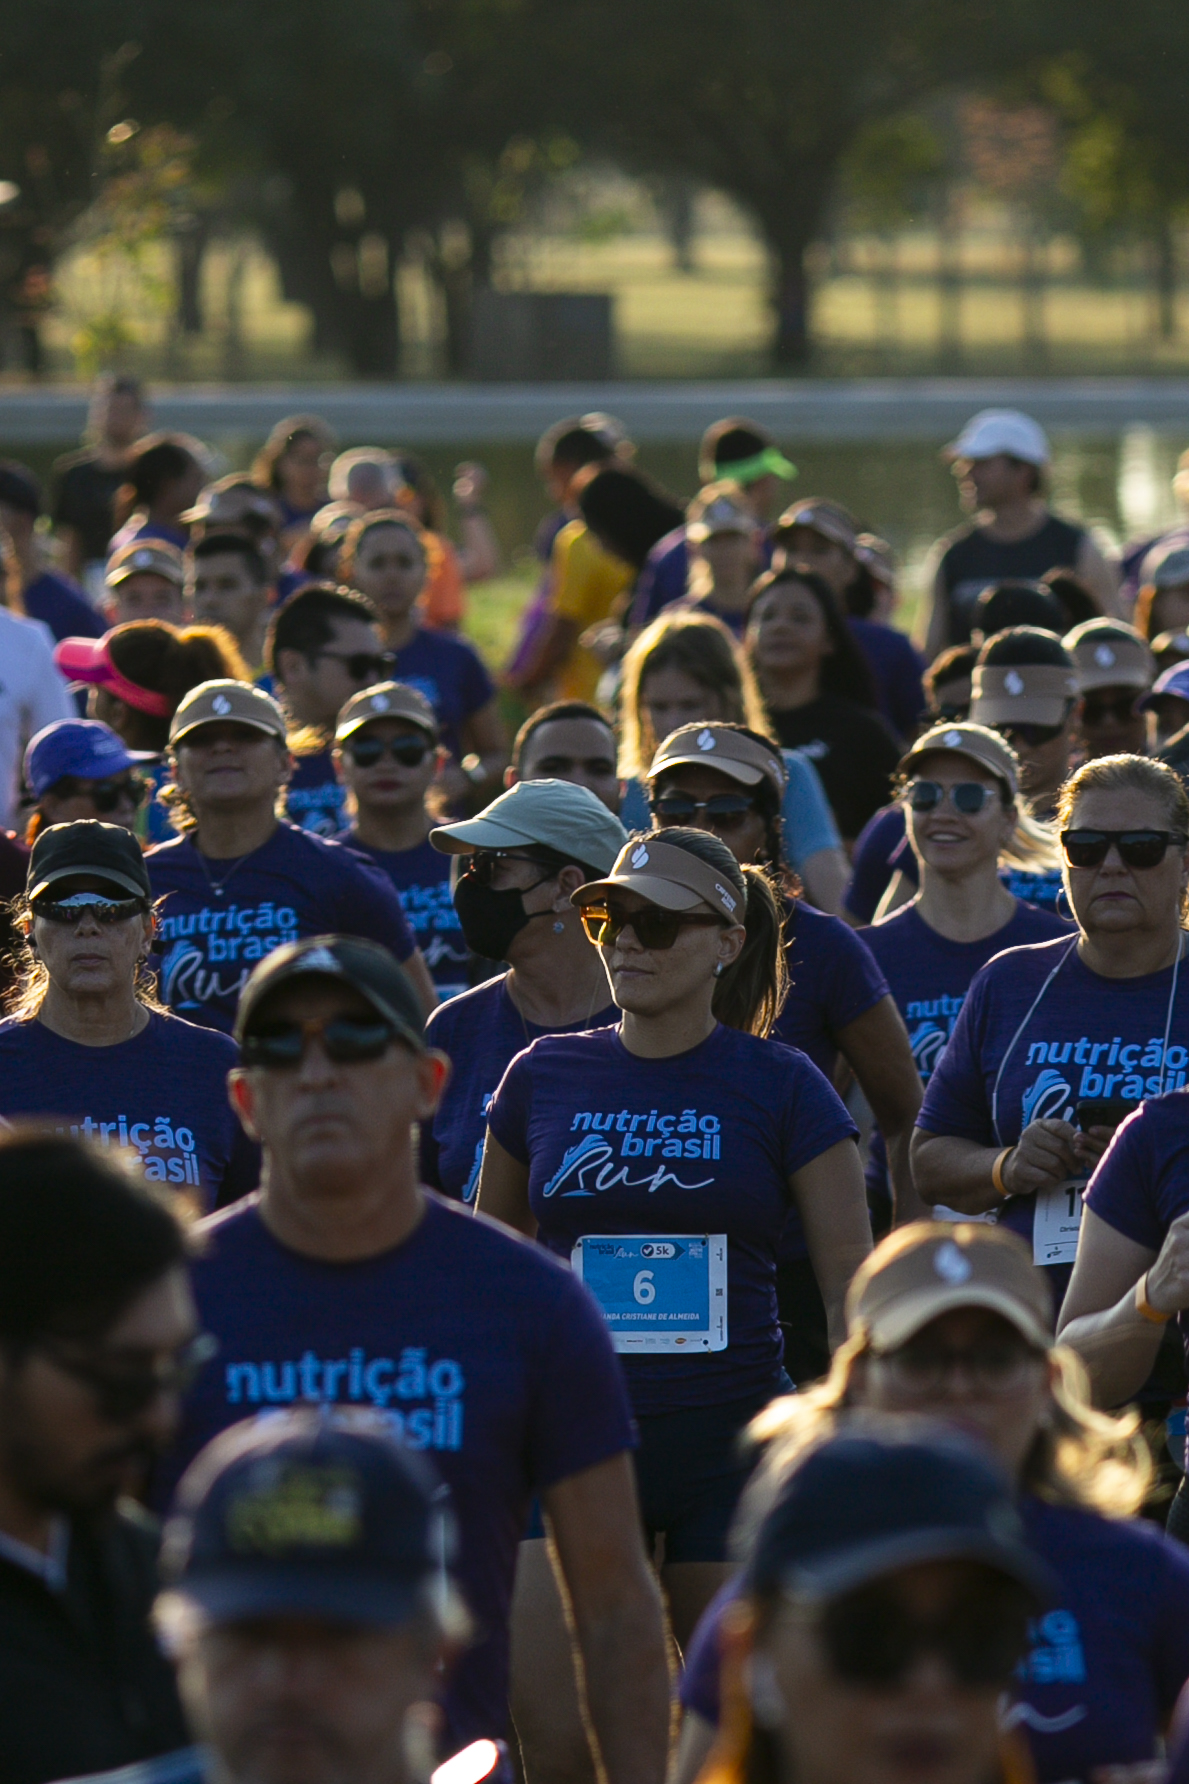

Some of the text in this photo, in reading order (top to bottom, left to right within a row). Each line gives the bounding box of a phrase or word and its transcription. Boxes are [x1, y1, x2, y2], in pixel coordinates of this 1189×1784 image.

[1025, 1037, 1189, 1073] nutrição
[569, 1109, 721, 1138] nutrição
[620, 1133, 721, 1160] brasil
[543, 1146, 715, 1197] Run
[655, 1246, 669, 1255] 5k
[633, 1269, 656, 1305] 6
[621, 1312, 657, 1320] CRISTIANE
[658, 1312, 668, 1320] DE
[668, 1312, 699, 1320] ALMEIDA
[225, 1346, 467, 1407] nutrição
